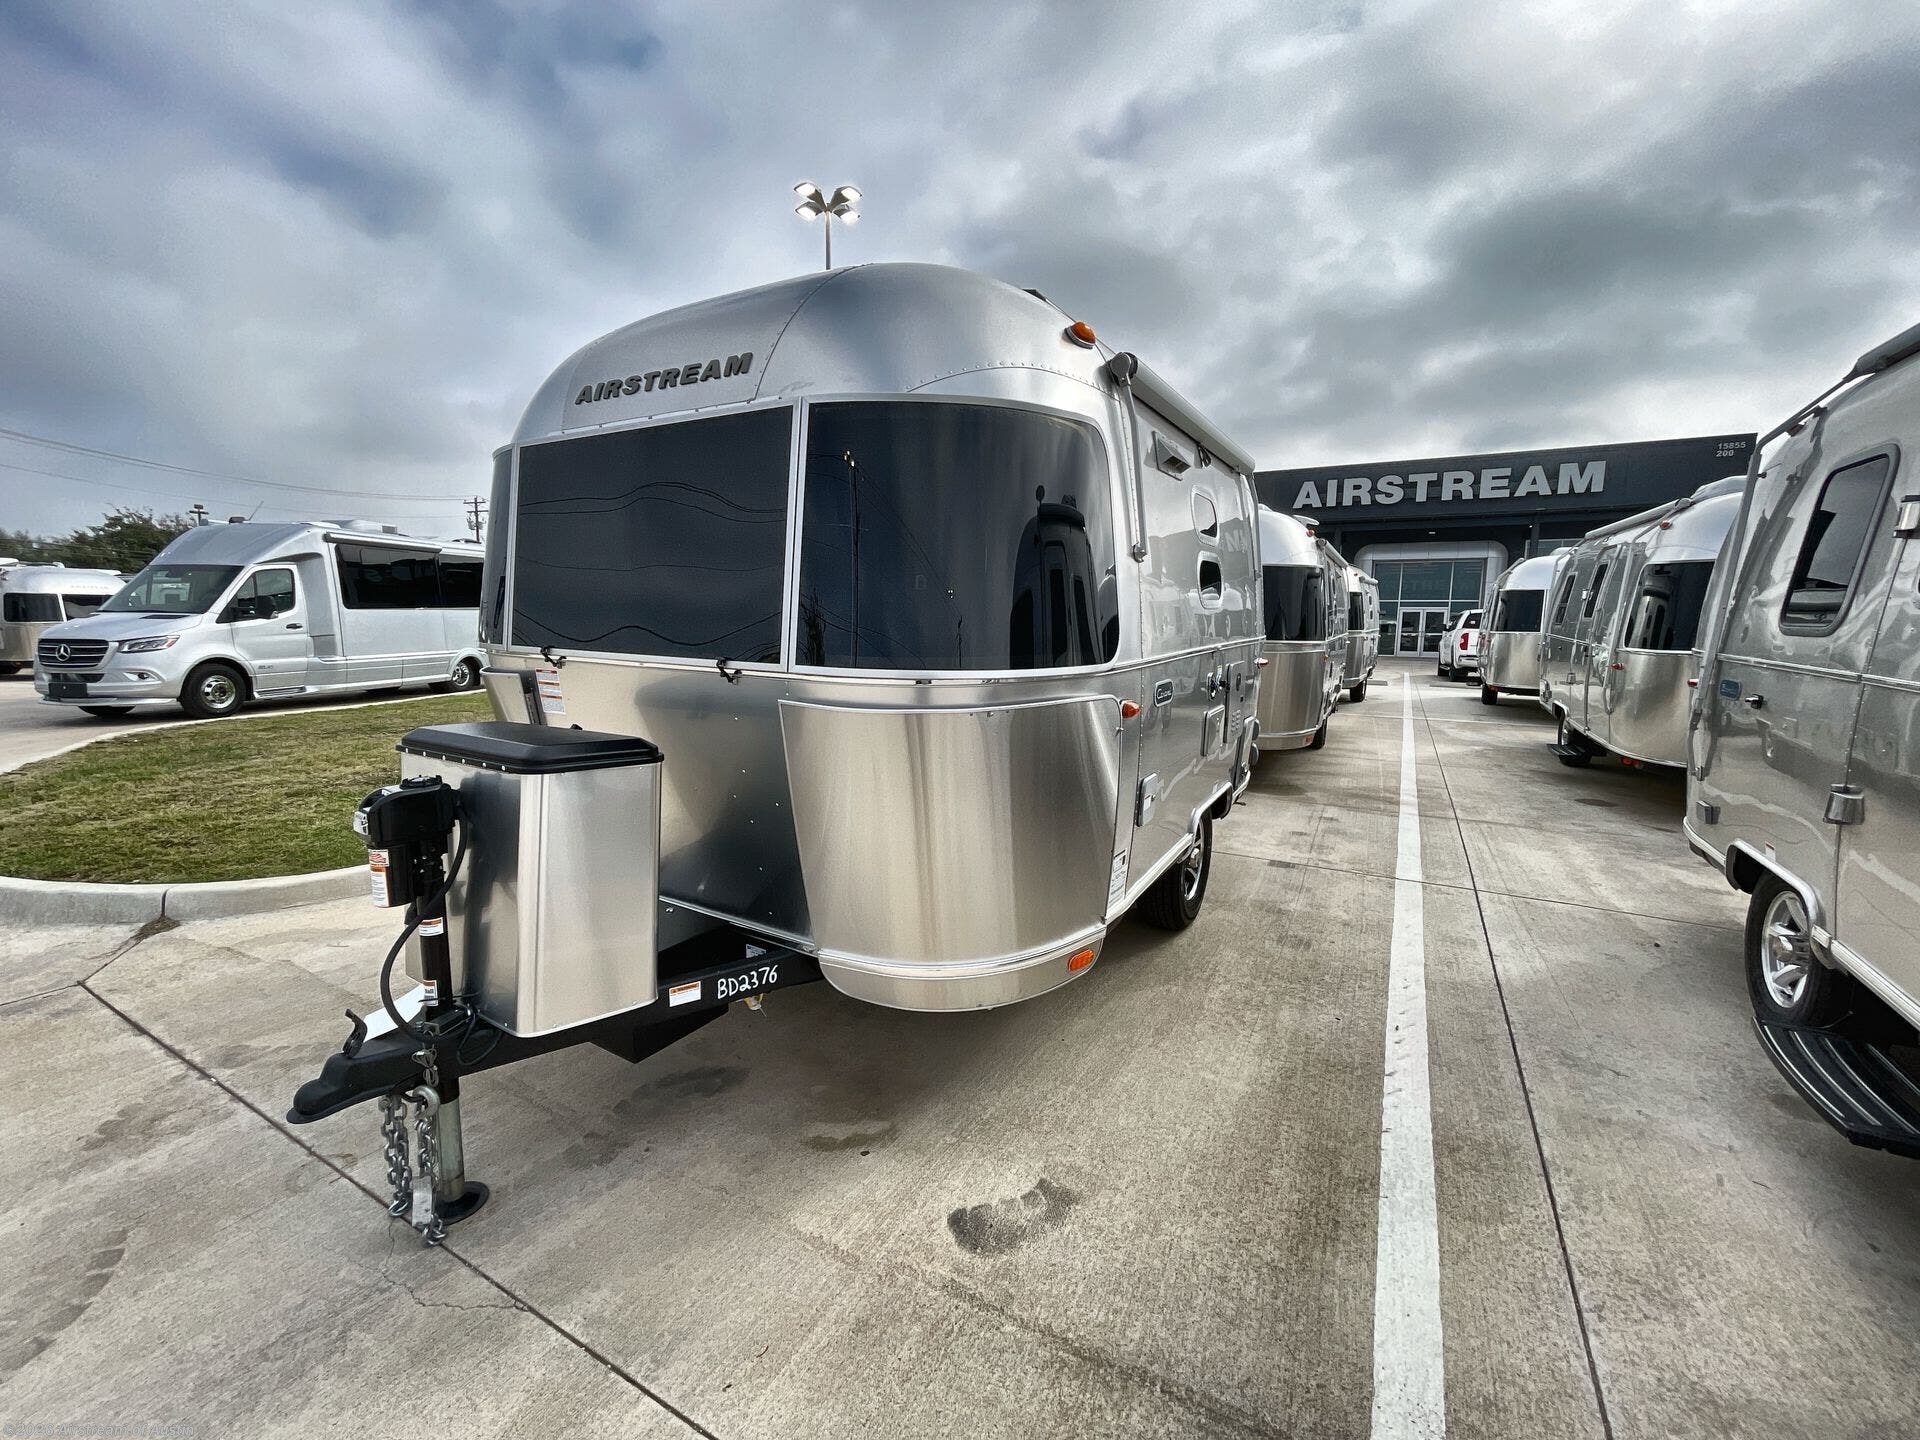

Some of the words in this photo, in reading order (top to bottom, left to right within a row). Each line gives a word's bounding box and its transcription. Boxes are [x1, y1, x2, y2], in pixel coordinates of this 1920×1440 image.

[574, 352, 753, 405] AIRSTREAM
[1292, 460, 1607, 509] AIRSTREAM
[717, 964, 779, 1000] BD2376
